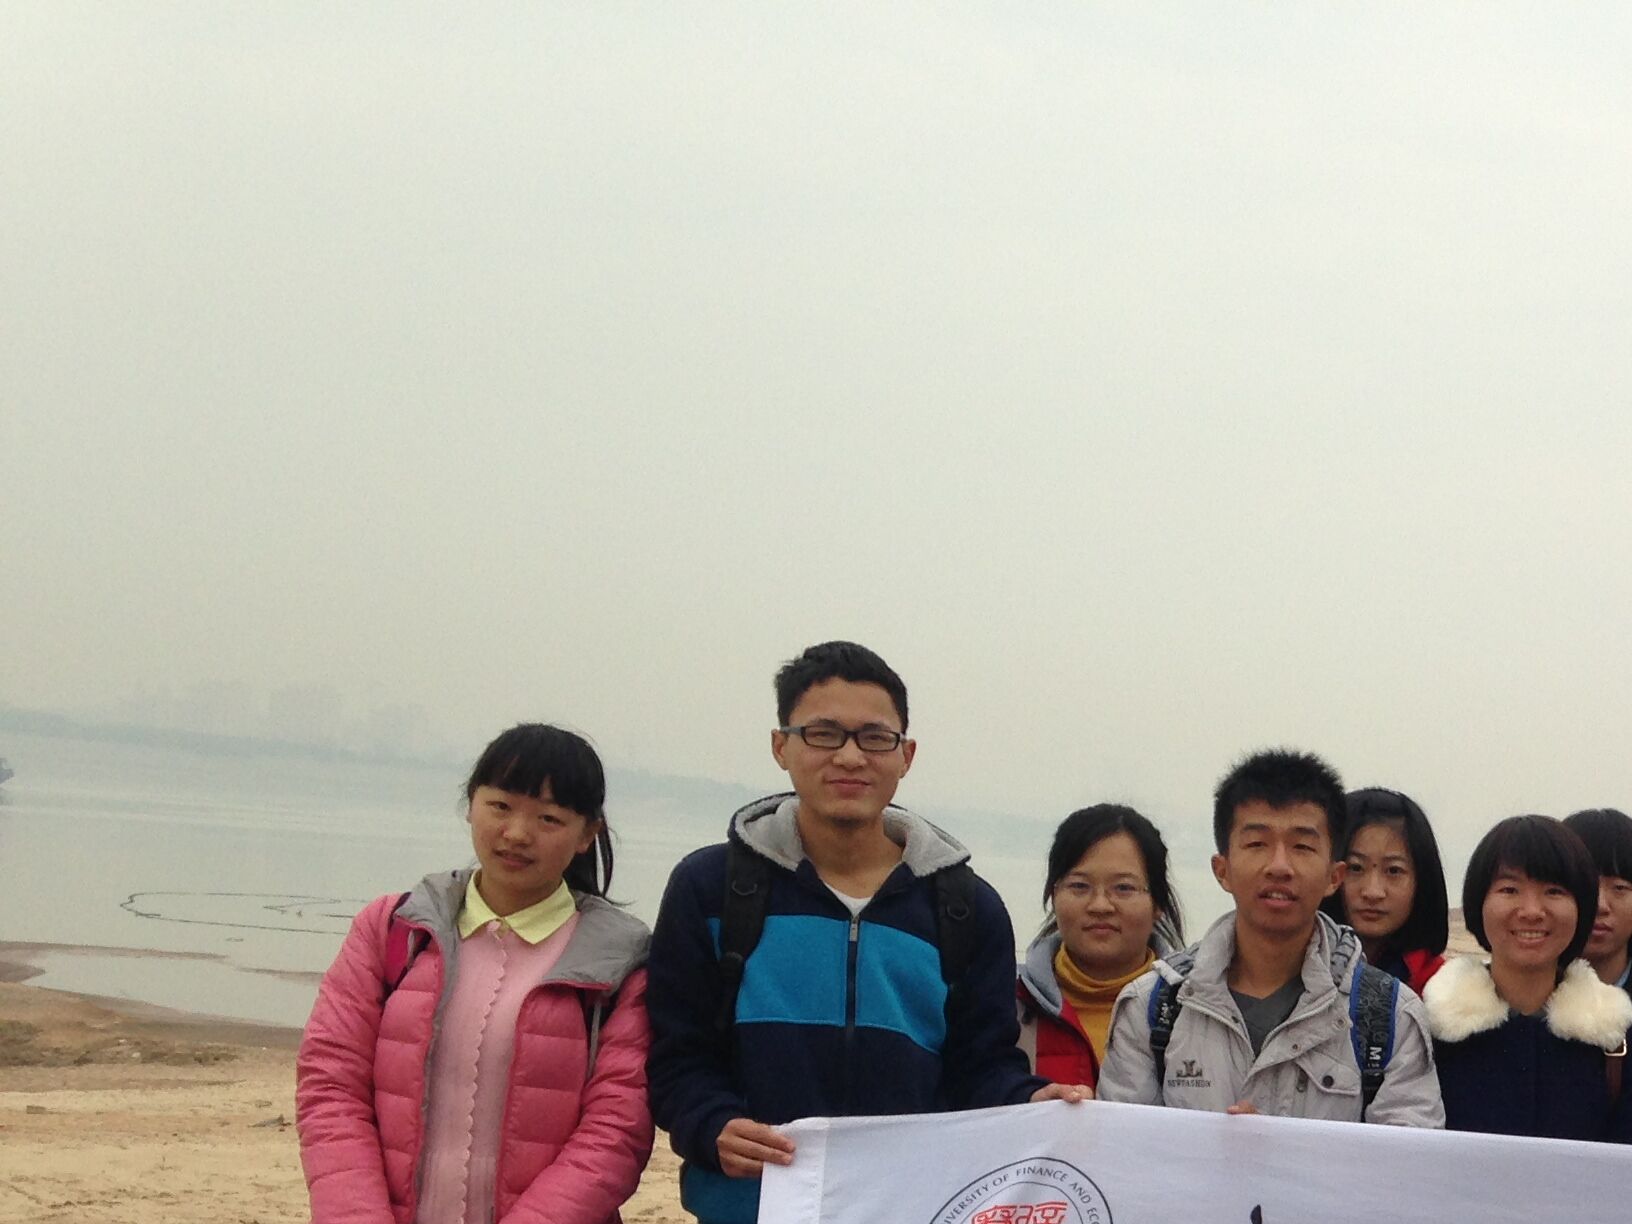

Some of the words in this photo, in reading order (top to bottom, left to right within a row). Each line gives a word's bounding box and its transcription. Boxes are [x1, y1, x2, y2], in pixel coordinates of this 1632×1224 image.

[992, 1173, 1009, 1187] OF
[1016, 1165, 1068, 1182] FINANCE
[1069, 1182, 1092, 1204] AND
